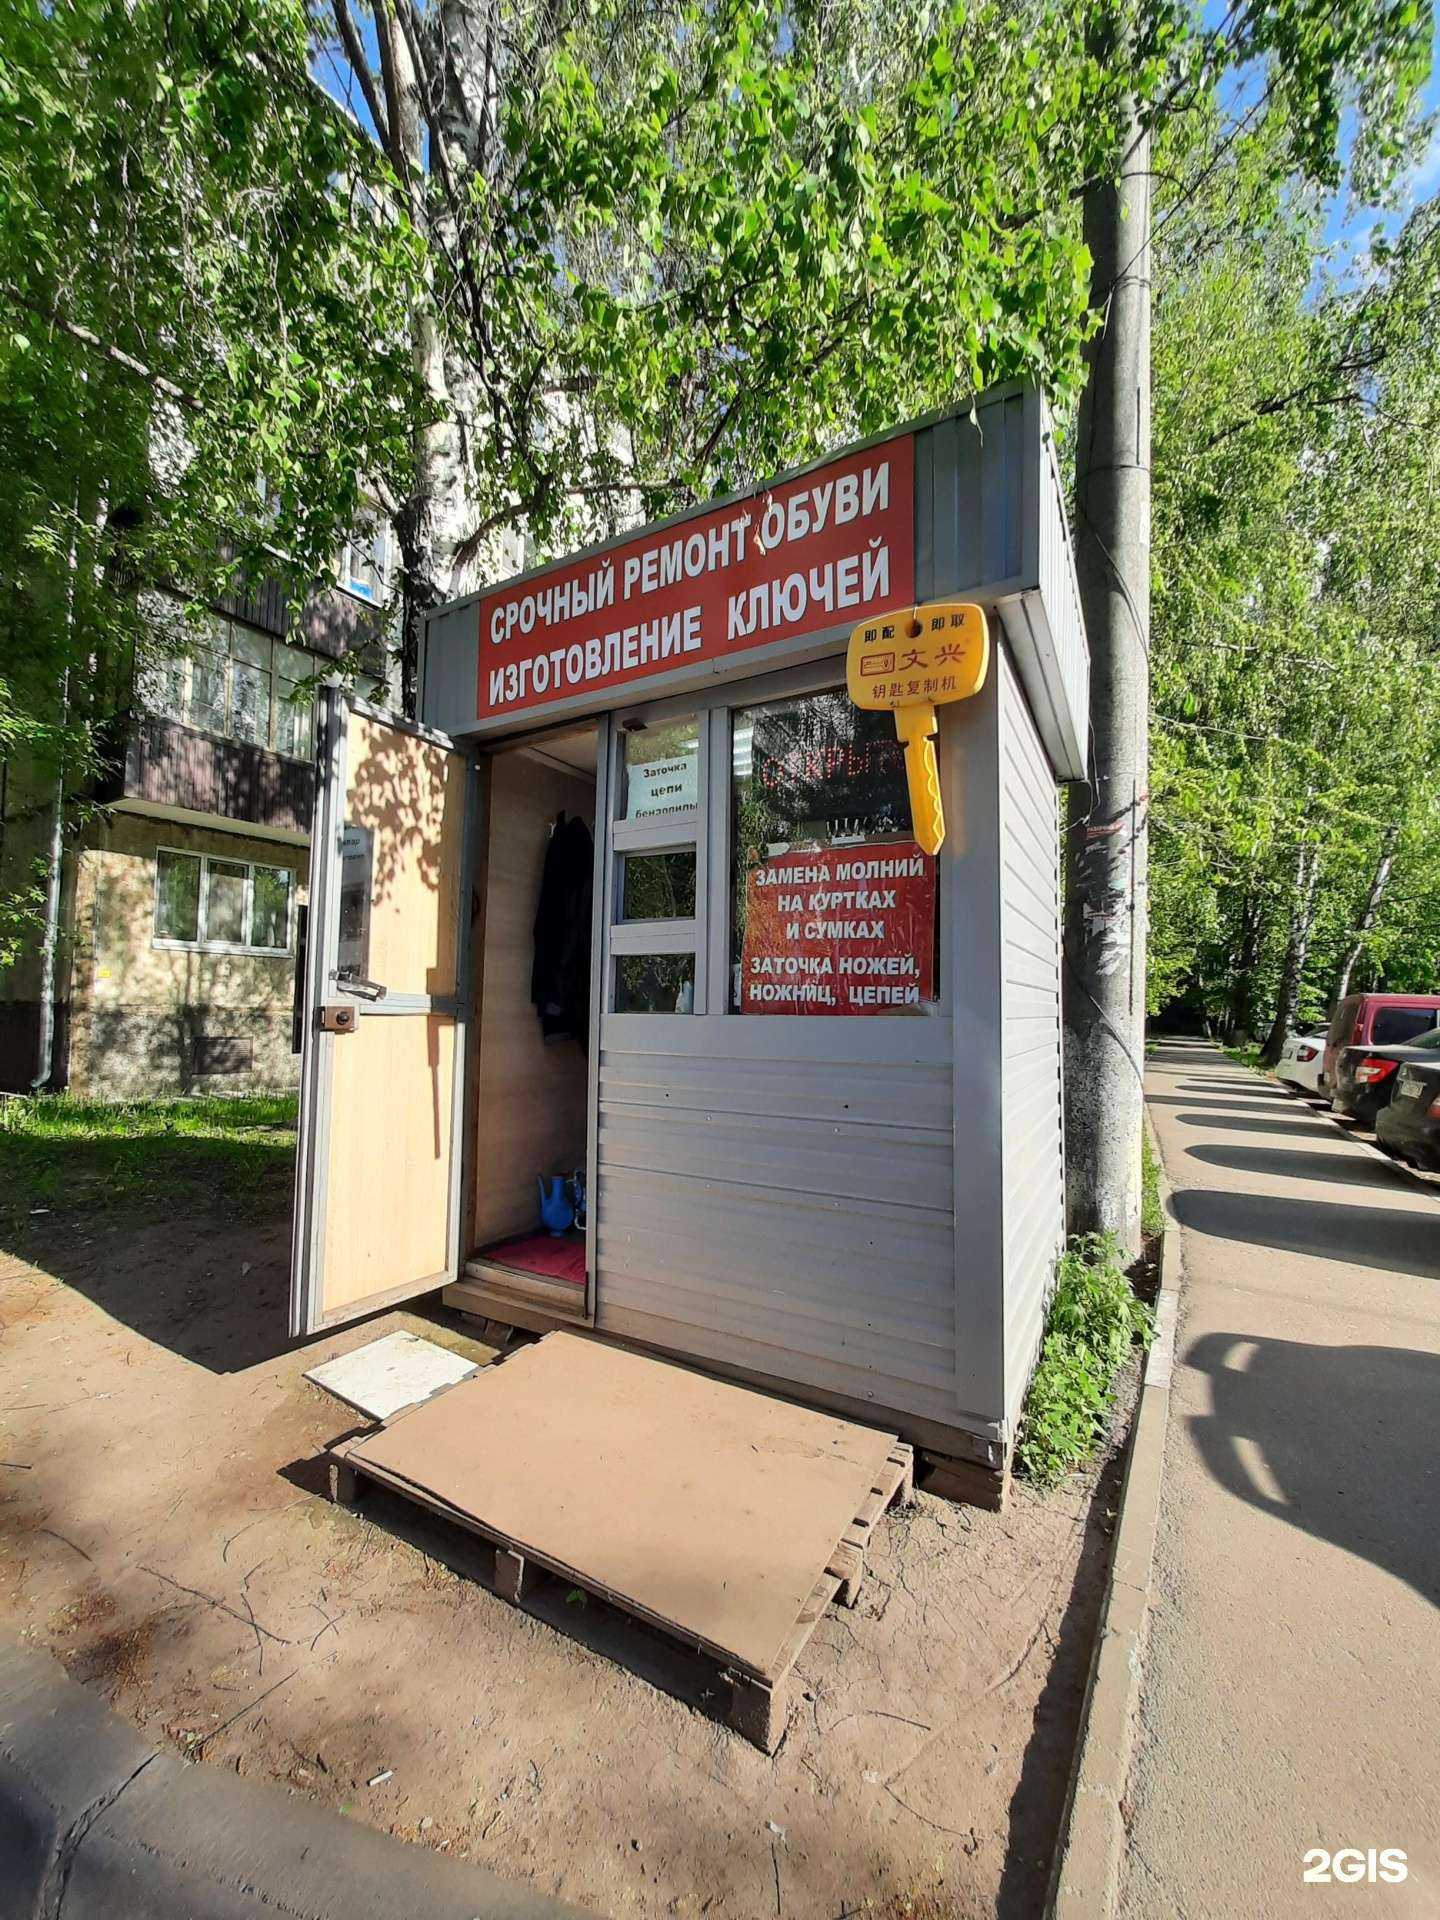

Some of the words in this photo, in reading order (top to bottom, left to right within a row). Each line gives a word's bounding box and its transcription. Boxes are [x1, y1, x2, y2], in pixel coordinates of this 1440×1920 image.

[489, 557, 614, 645] СРОЧНЫЙ
[623, 512, 752, 601] РЕМОНТ
[760, 461, 889, 550] ОБУВИ
[488, 604, 702, 706] ИЗГОТОВЛЕНИЕ
[727, 534, 889, 641] КЛЮЧЕЙ
[872, 675, 958, 700] 钥匙复制机
[642, 762, 687, 778] Заточка
[650, 783, 683, 798] цепи
[756, 864, 831, 887] ЗАМЕНА
[836, 853, 924, 881] МОЛНИЙ
[777, 894, 804, 912] НА
[808, 889, 896, 911] КУРТКАХ
[786, 922, 800, 940] И
[804, 920, 885, 939] СУМКАХ
[751, 956, 834, 975] ЗАТОЧКА
[838, 952, 920, 978] НОЖЕЙ,
[749, 983, 837, 1006] НОЖНИЦ,
[849, 983, 920, 1007] ЦЕПЕЙ
